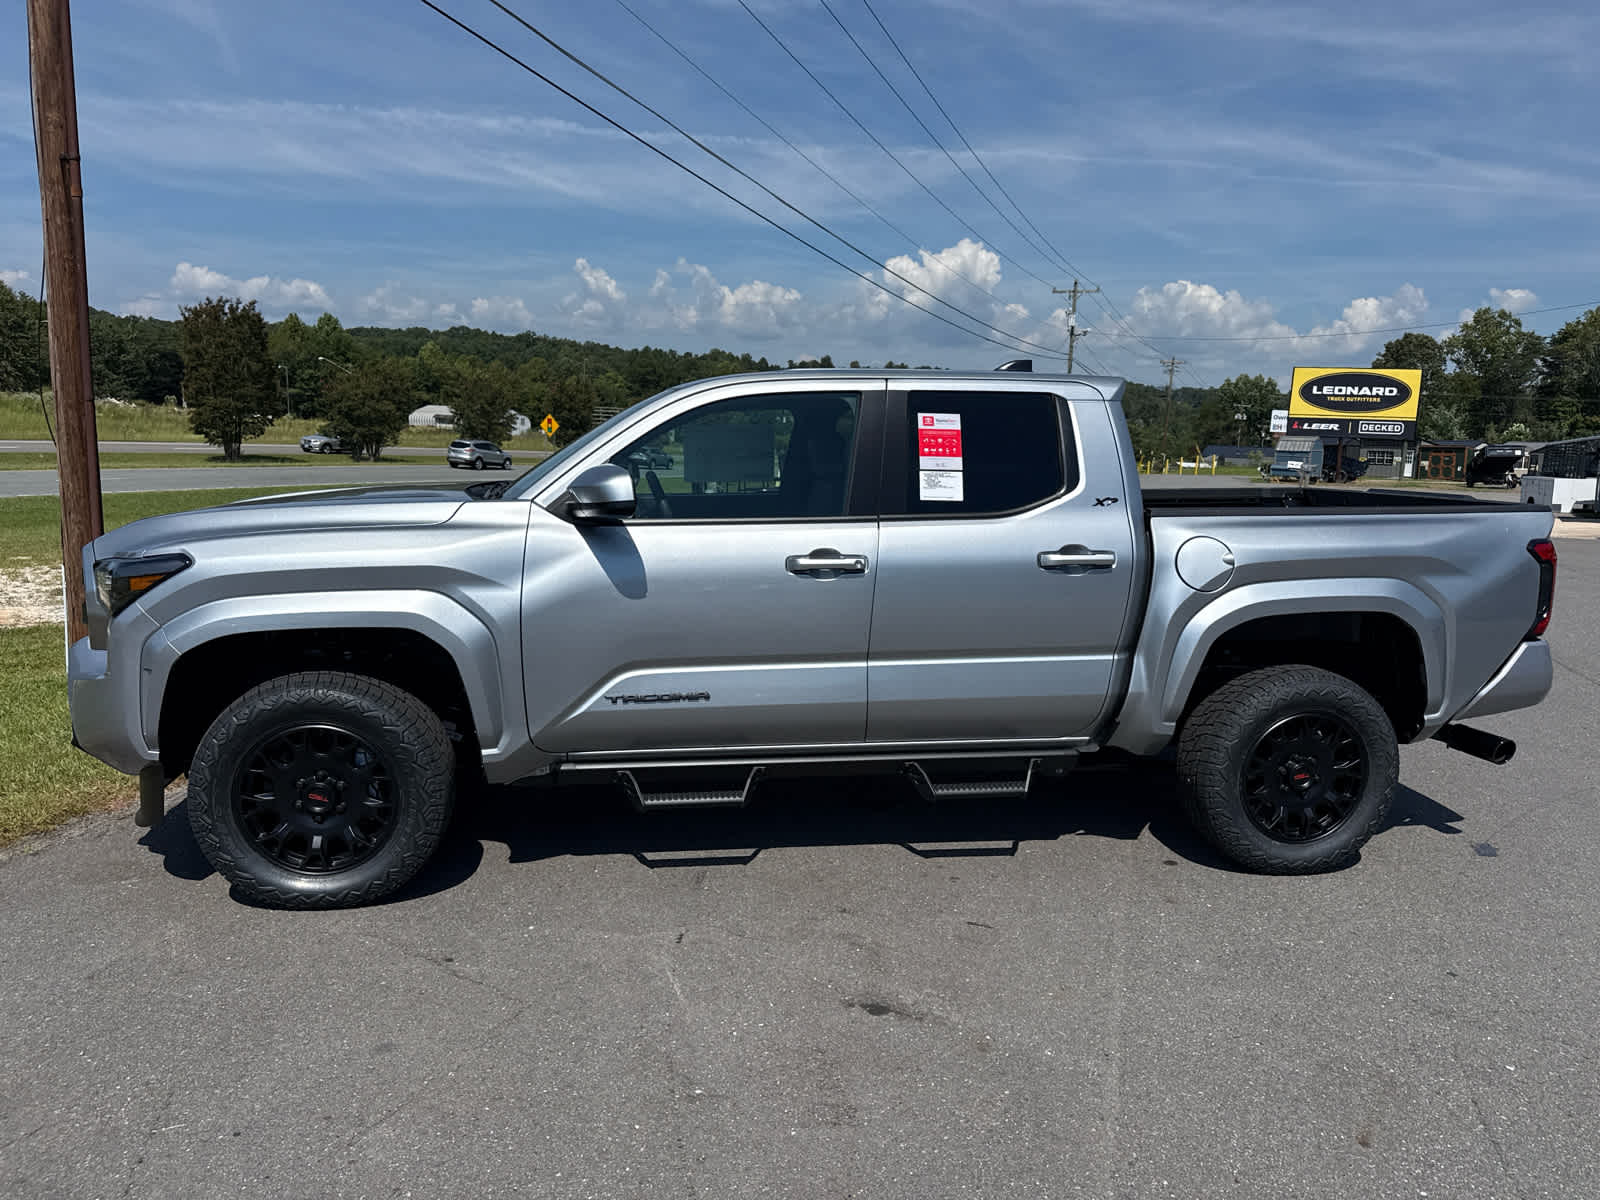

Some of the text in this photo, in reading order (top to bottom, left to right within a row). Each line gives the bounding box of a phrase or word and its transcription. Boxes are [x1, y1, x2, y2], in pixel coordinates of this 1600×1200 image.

[1312, 385, 1398, 396] LEONARD
[1303, 422, 1340, 430] LEER
[1362, 423, 1401, 432] DECKED
[604, 691, 711, 705] TACOMA
